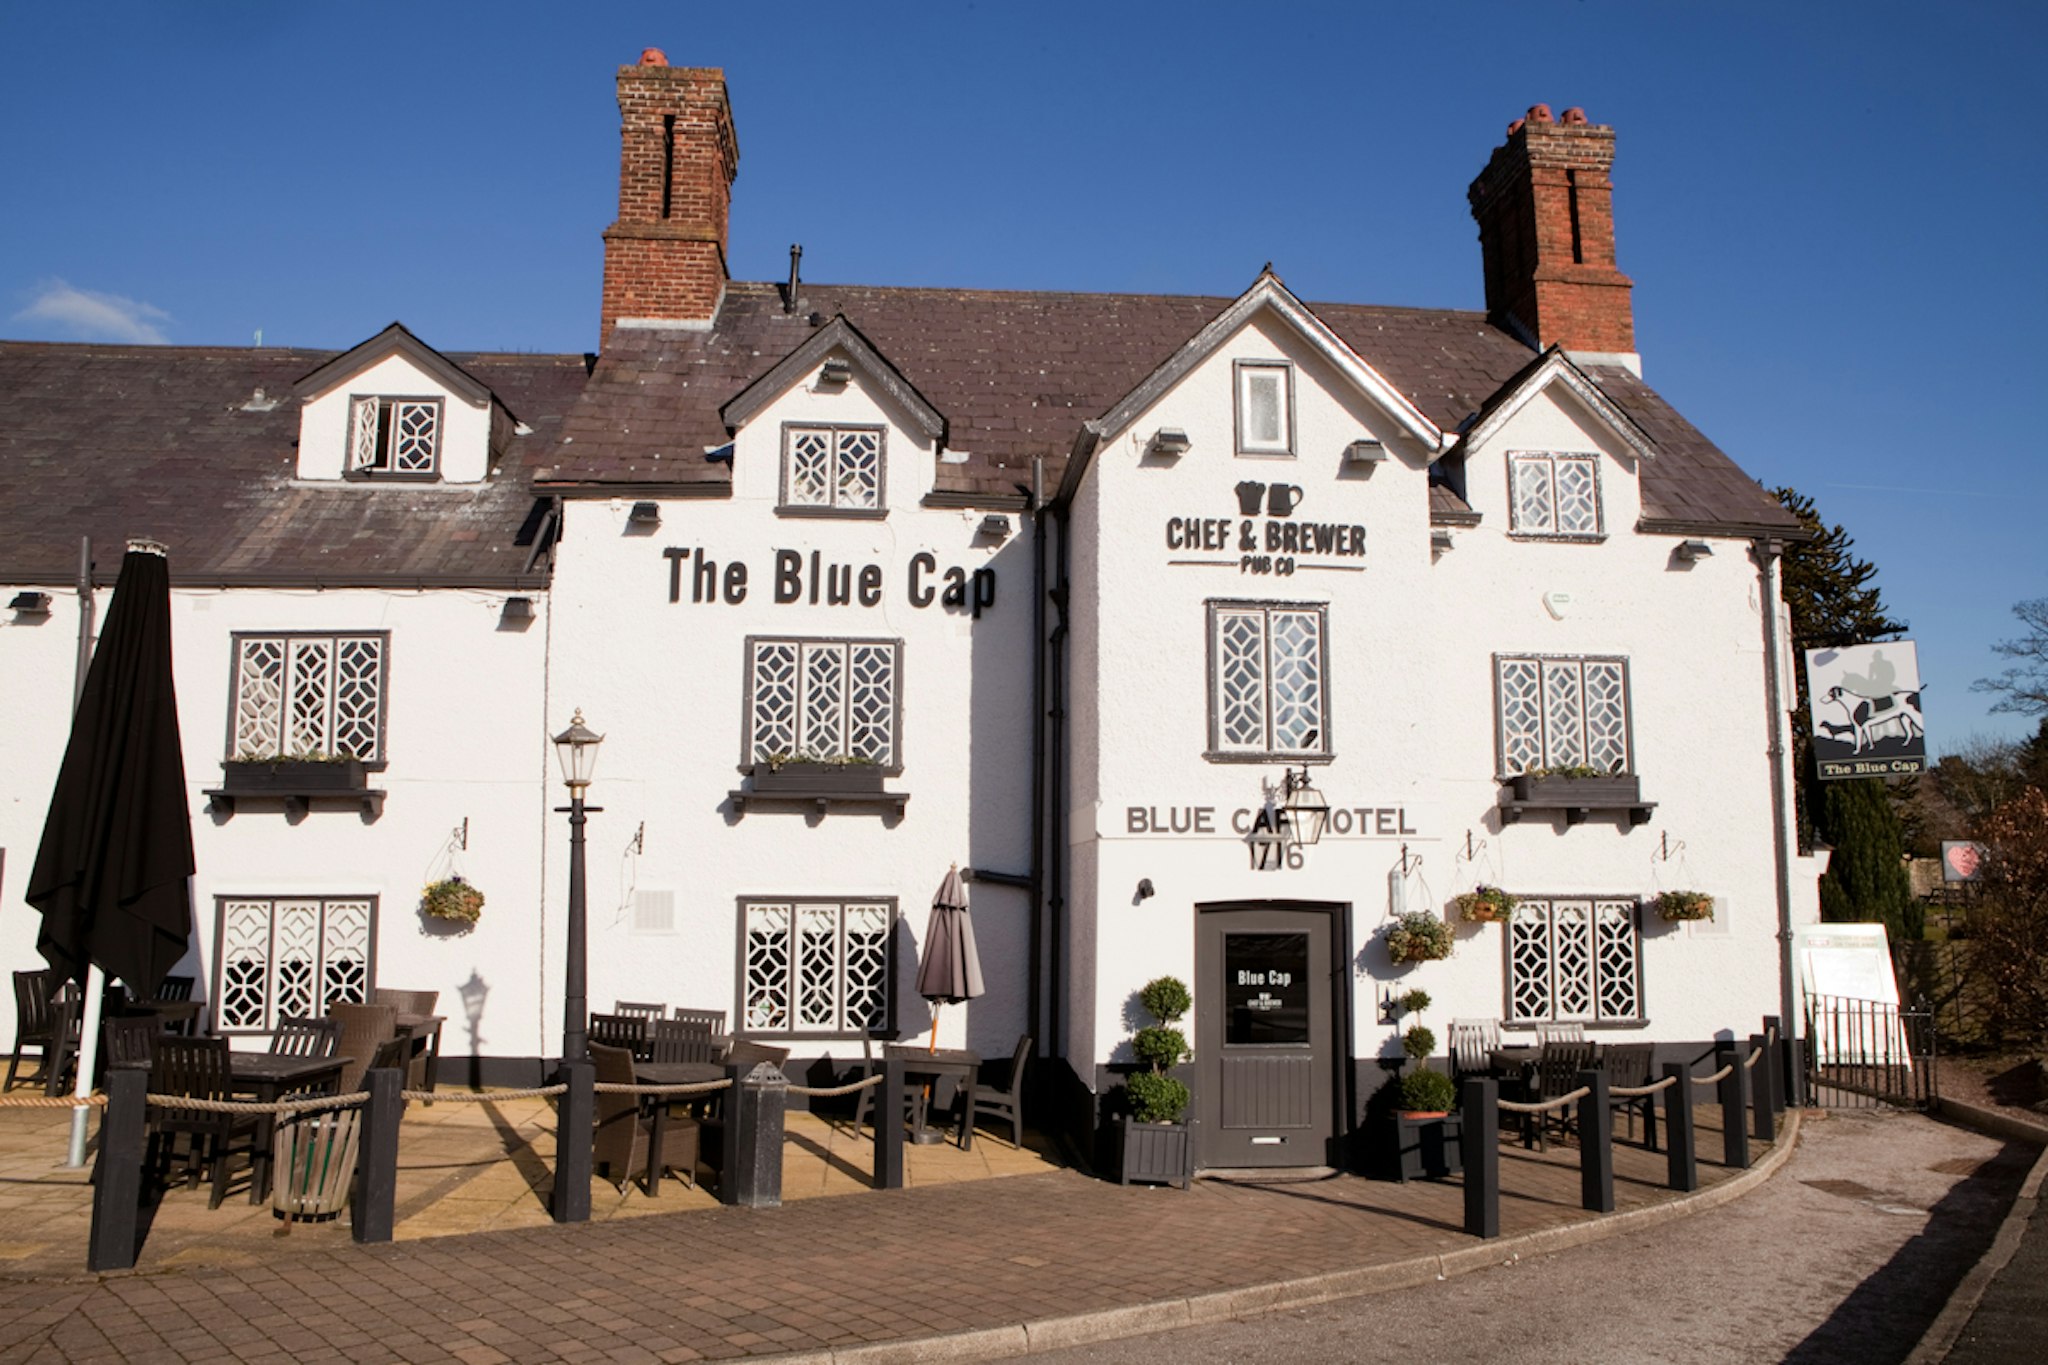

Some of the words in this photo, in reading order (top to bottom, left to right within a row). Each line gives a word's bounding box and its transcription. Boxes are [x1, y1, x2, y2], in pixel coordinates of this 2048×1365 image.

[1166, 517, 1232, 550] CHEF
[1238, 519, 1257, 551] &
[1265, 520, 1366, 556] BREWER
[1241, 555, 1272, 575] PUB
[1275, 557, 1295, 577] CO
[662, 547, 748, 606] The
[773, 548, 883, 608] Blue
[907, 551, 996, 619] Cap
[1824, 763, 1851, 775] The
[1855, 761, 1888, 774] Blue
[1891, 760, 1919, 774] Cap
[1126, 806, 1216, 834] BLUE
[1324, 807, 1418, 835] OTEL
[1249, 841, 1304, 871] 1716
[1238, 970, 1265, 985] Blue
[1269, 970, 1291, 987] Cap
